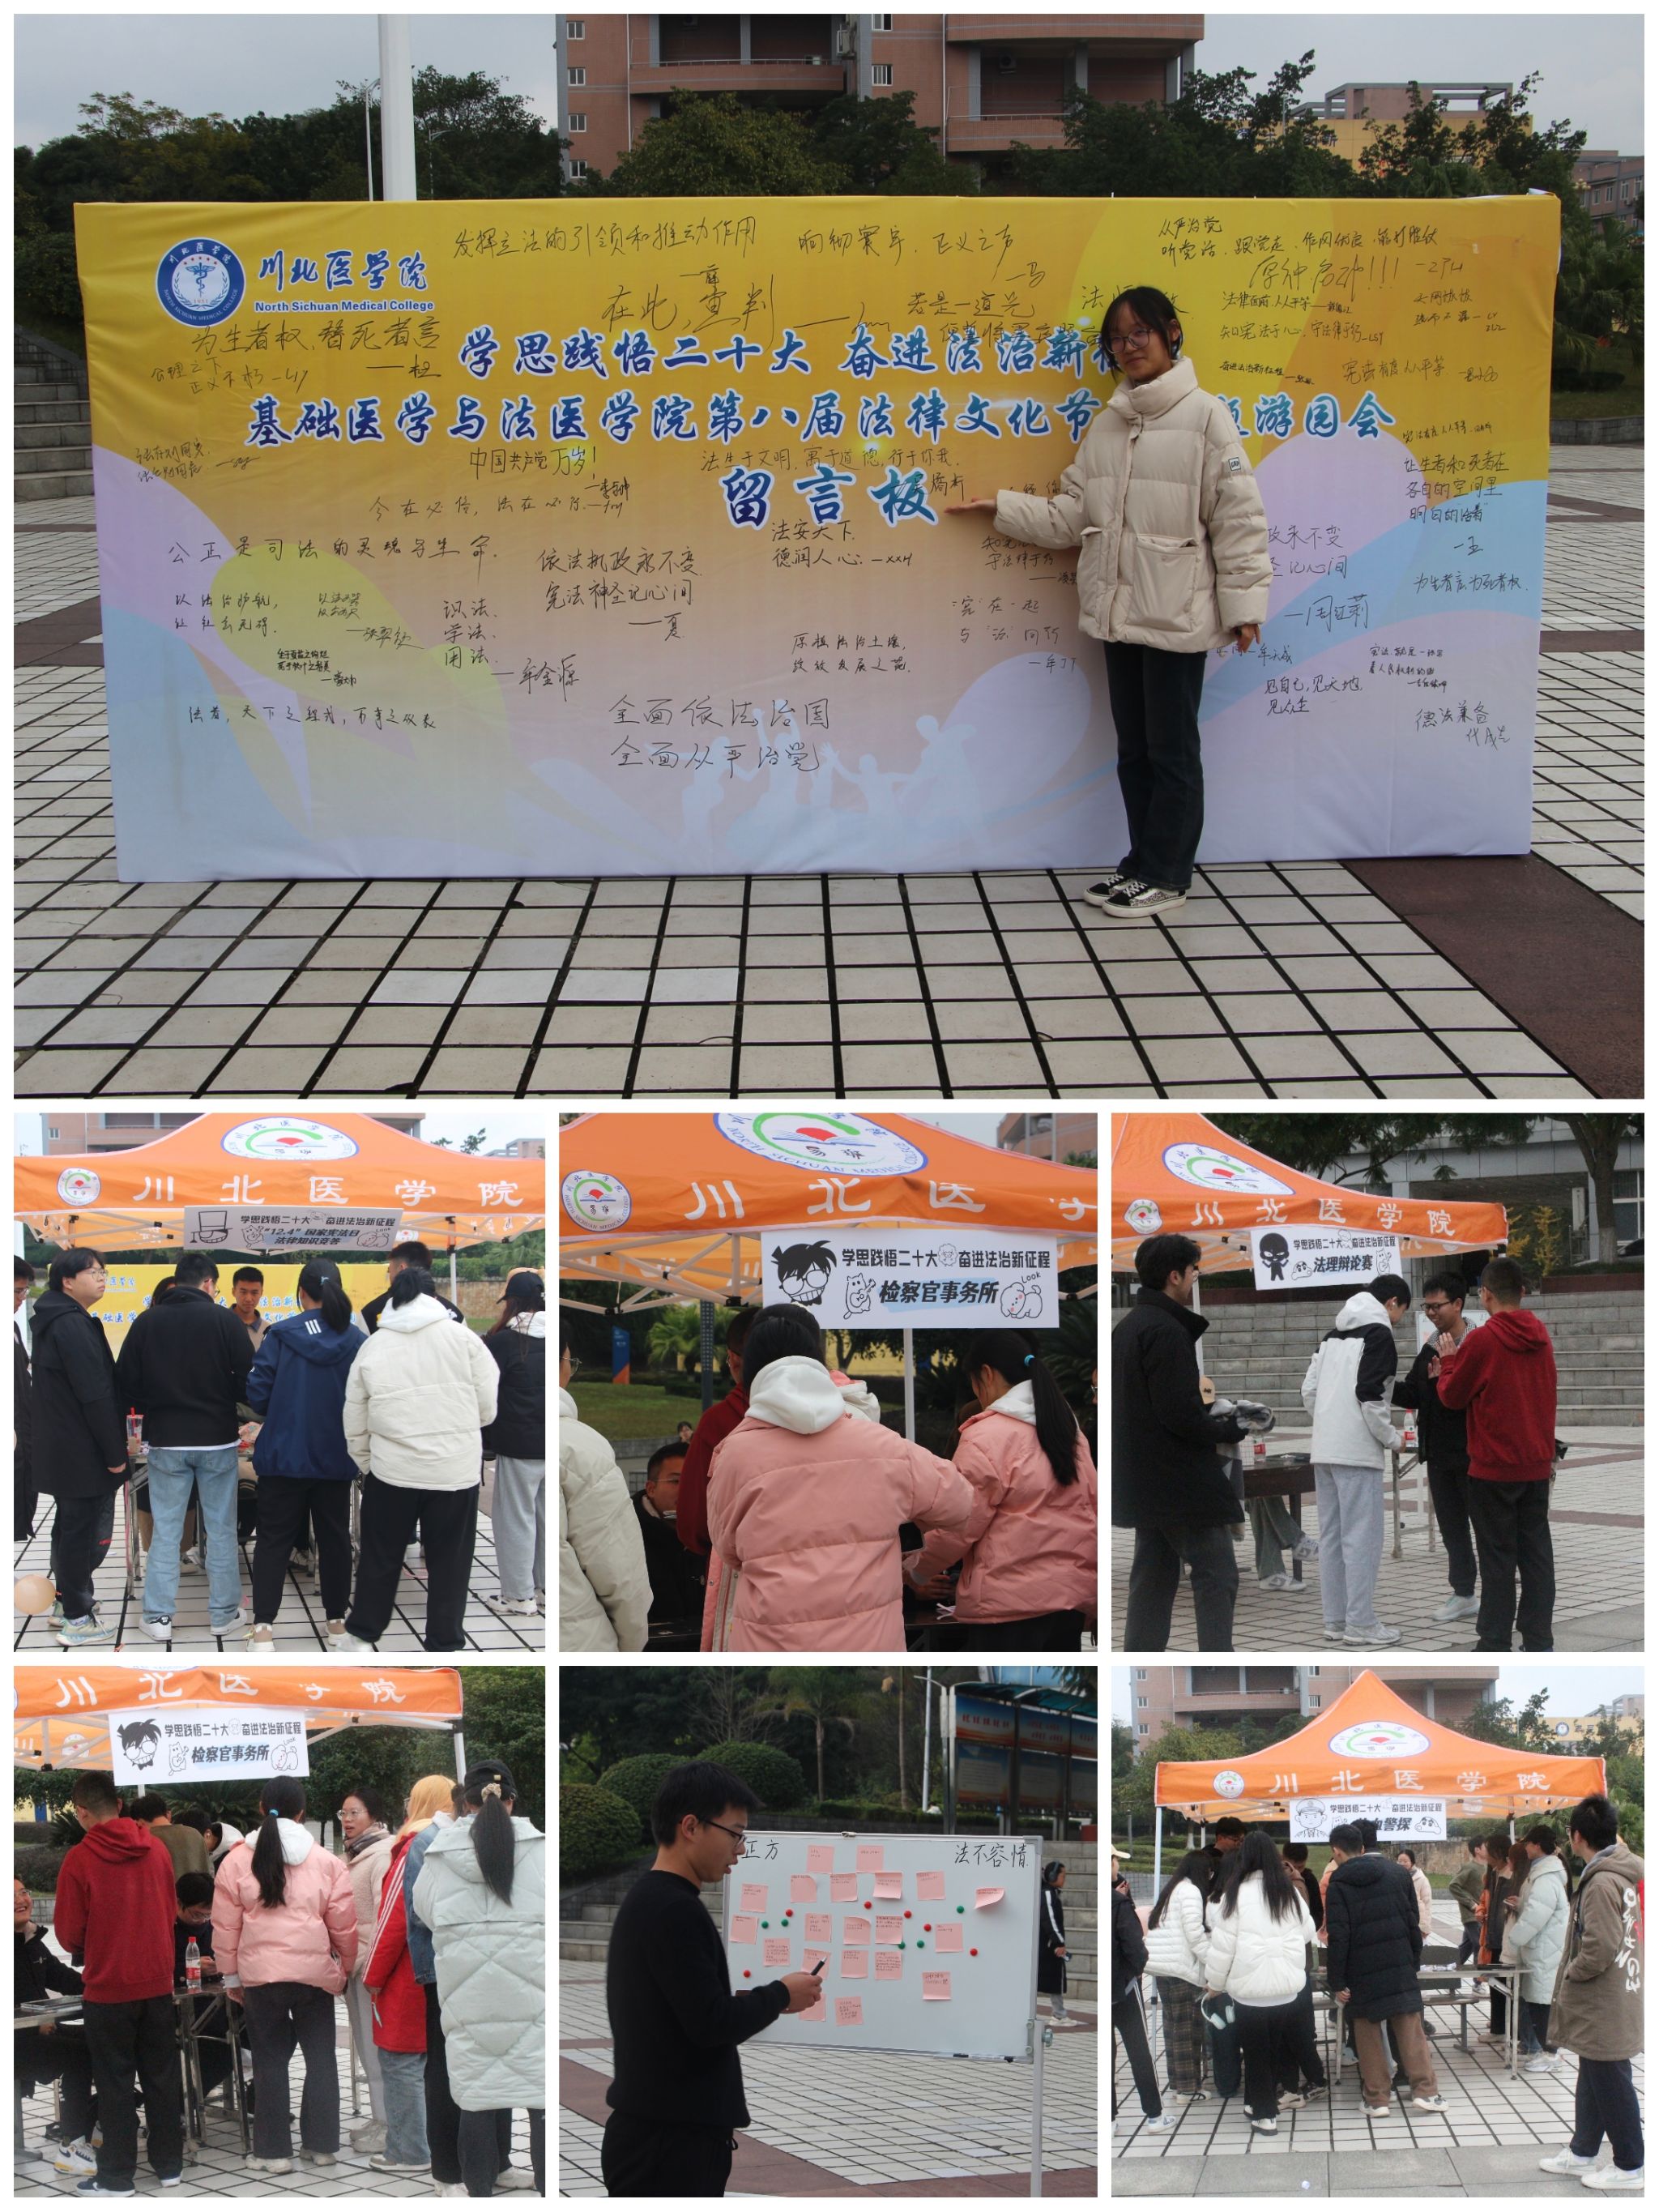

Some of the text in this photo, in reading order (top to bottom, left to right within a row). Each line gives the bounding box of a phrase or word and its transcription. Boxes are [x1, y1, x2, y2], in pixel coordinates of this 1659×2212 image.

[454, 216, 757, 259] 发挥立法的引领和推动作用
[258, 250, 429, 291] 川北医学院
[255, 301, 434, 314] North Sichuan Medical College
[907, 291, 1036, 318] 若是一道光
[460, 325, 1120, 379] 学思践悟二十大 奋进法治新
[246, 392, 1099, 446] 基础医学与法医学院第八届法律文化节
[1404, 451, 1509, 475] 让生者和死者在
[722, 468, 935, 525] 留言板
[1406, 476, 1503, 499] 各自的空间里
[609, 694, 830, 729] 全面依法治国
[1416, 700, 1489, 732] 德法兼备
[770, 1152, 844, 1172] SICHUAN
[132, 1175, 524, 1207] 川北医学院
[241, 1215, 396, 1227] 学思践悟二十大 奋进法治新征程
[1191, 1198, 1455, 1236] 川北医学院
[274, 1236, 341, 1245] 法律知识竞答
[305, 1228, 360, 1236] 国家宪法日
[1293, 1236, 1397, 1250] 学思践悟二十大 奋进法治新征程
[842, 1248, 1051, 1270] 学思践悟二十大 奋进法治新征程
[1313, 1254, 1374, 1274] 法理辩论赛
[1021, 1272, 1041, 1283] Look
[879, 1279, 1000, 1305] 检察官事务所
[164, 1721, 302, 1737] 学思践悟二十大 奋进法治新征程
[191, 1744, 270, 1764] 检察官事务所
[1269, 1770, 1550, 1793] 川北医学院
[1330, 1802, 1443, 1814] 学思践悟二十大 奋进法治新征程
[741, 1839, 780, 1860] 正方
[954, 1841, 1030, 1868] 法不容情
